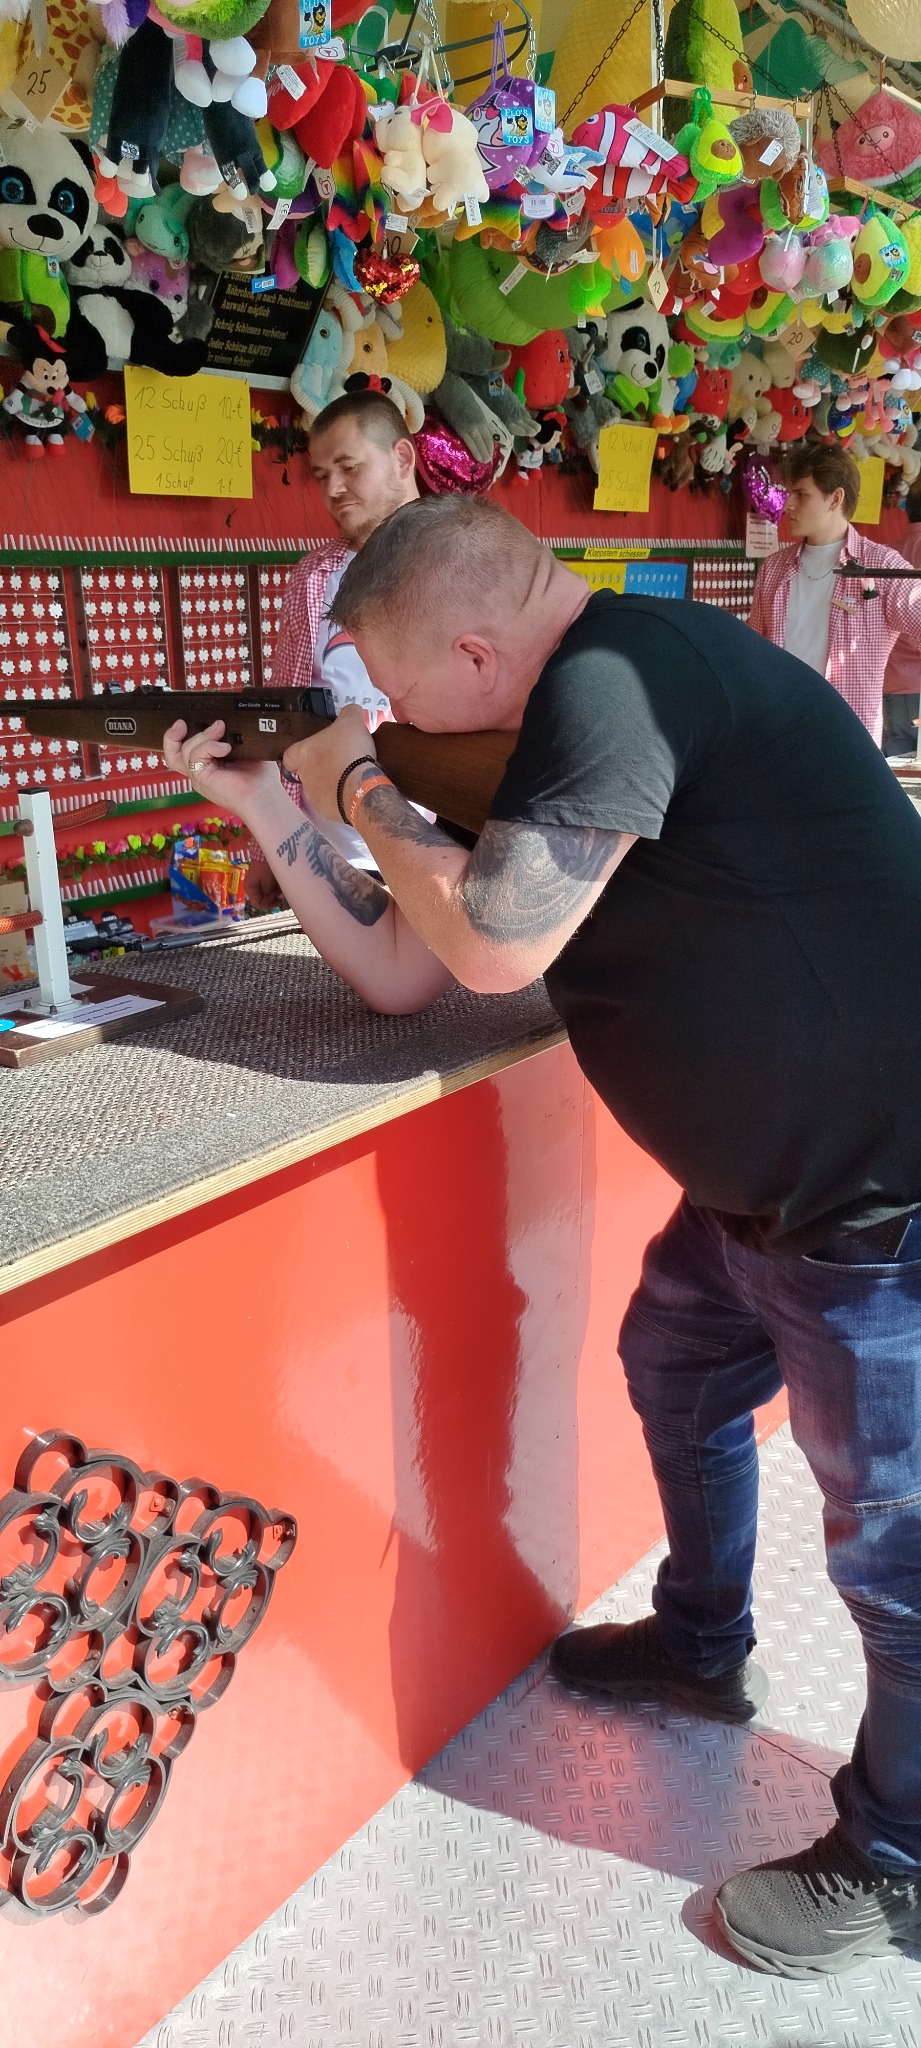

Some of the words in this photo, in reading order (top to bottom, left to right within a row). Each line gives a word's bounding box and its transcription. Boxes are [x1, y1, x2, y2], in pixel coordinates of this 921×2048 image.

[303, 33, 327, 46] TOYS
[27, 69, 51, 96] 25
[505, 109, 529, 117] FLO'S
[507, 135, 530, 144] TOYS
[653, 281, 661, 295] 12
[787, 332, 803, 346] 20
[134, 386, 156, 409] 12
[160, 388, 207, 423] Schuß
[132, 434, 156, 461] 25
[162, 436, 204, 472] Schuß
[156, 473, 163, 488] 1
[165, 472, 195, 492] Schuß
[333, 695, 387, 707] AMPA
[107, 720, 134, 732] DIANA
